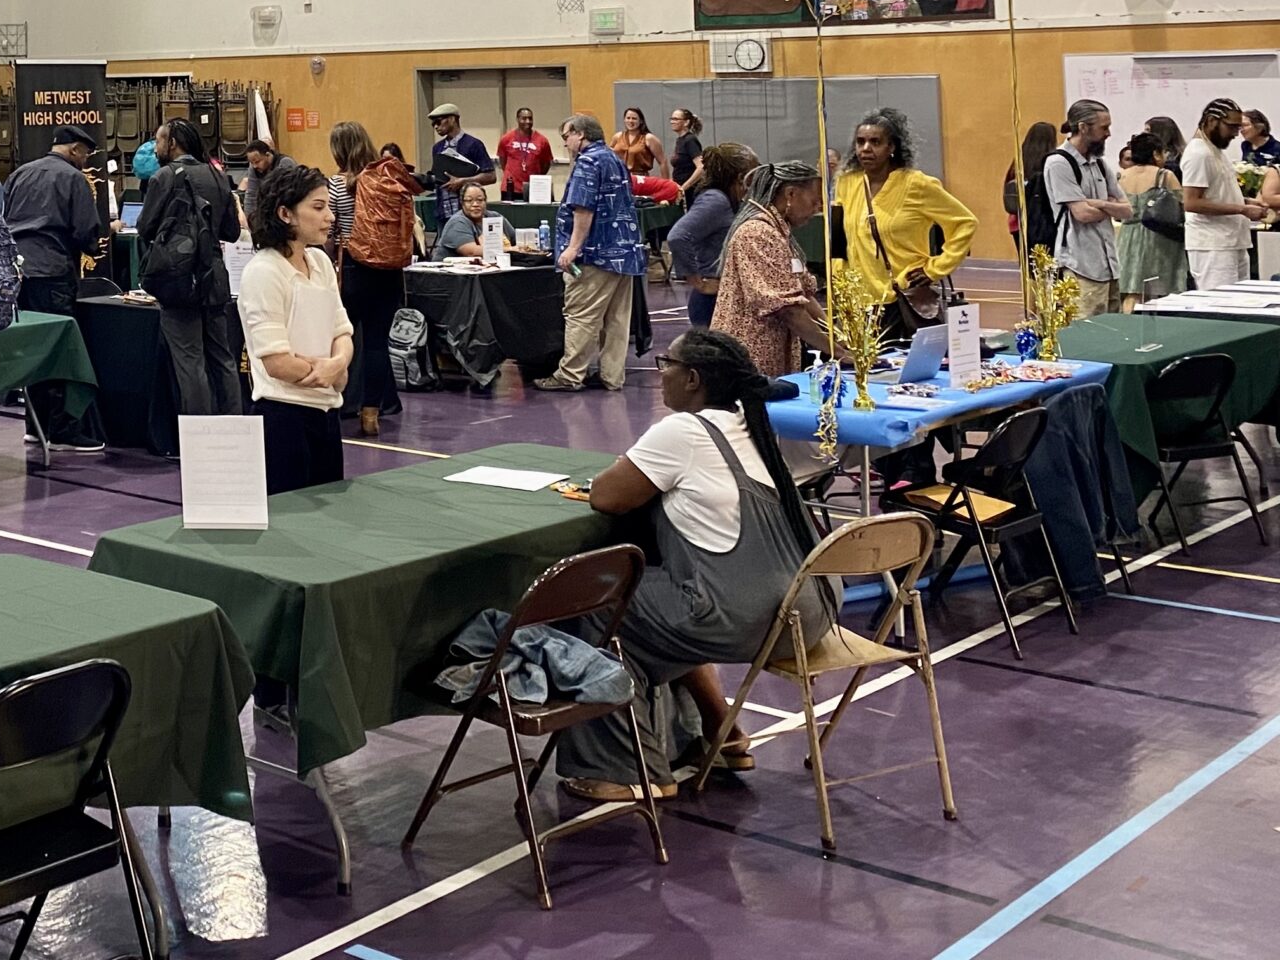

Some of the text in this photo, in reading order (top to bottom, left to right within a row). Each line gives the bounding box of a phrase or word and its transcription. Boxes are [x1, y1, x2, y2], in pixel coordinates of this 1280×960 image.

[34, 90, 92, 105] METWEST
[23, 110, 103, 126] HIGH SCHOOL
